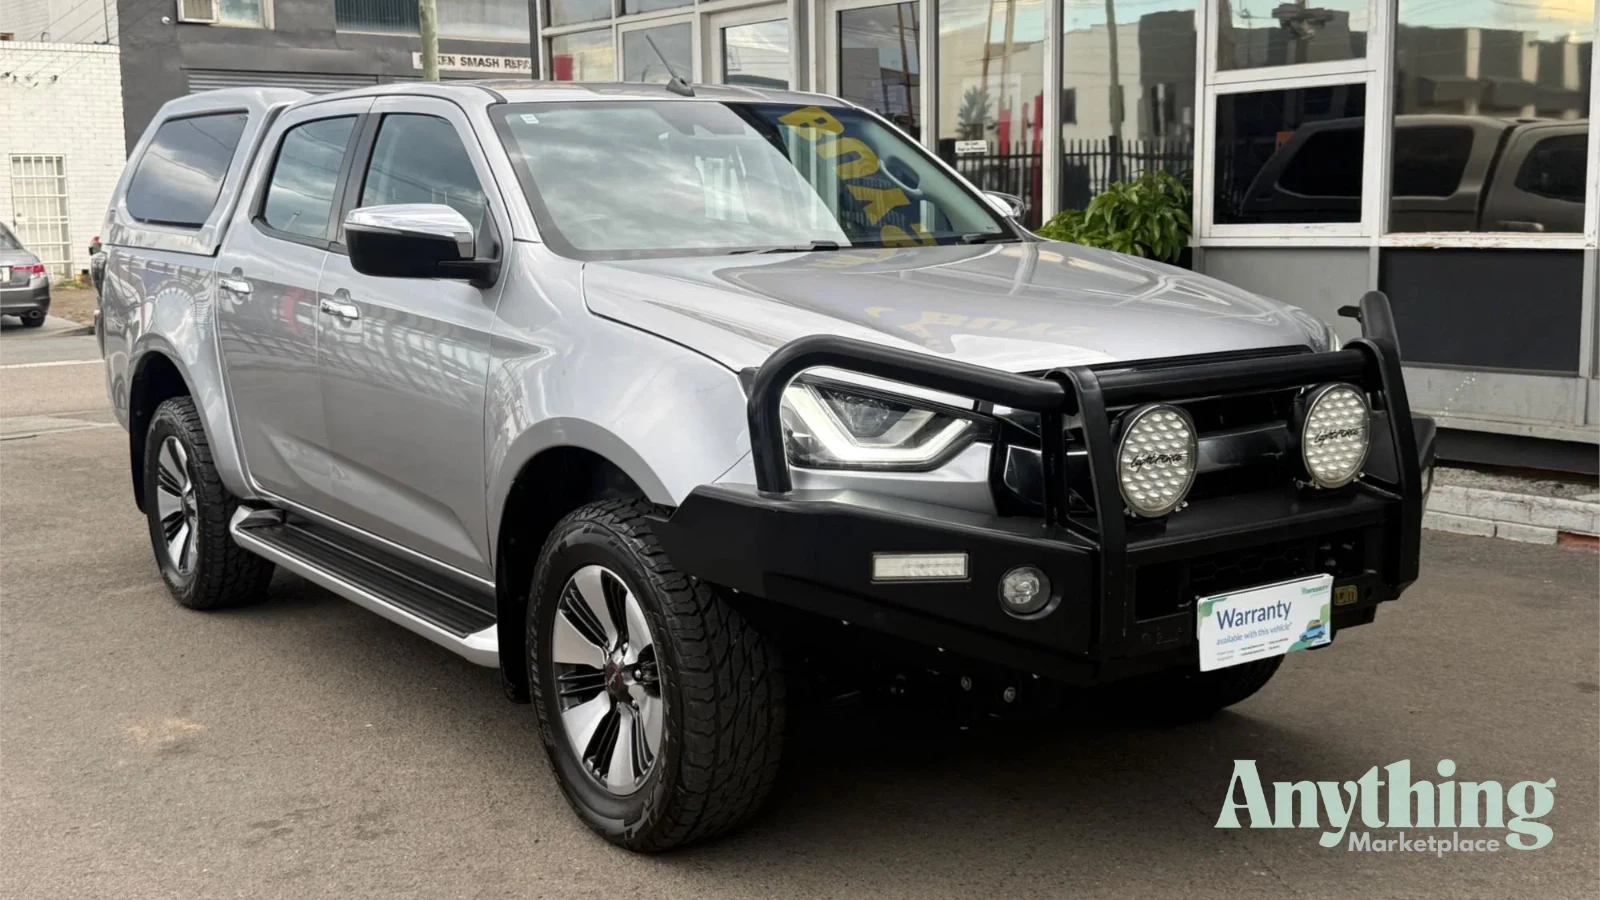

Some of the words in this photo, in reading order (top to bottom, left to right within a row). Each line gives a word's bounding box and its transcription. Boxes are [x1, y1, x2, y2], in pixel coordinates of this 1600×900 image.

[460, 56, 500, 68] SMASH
[1216, 600, 1292, 630] Warranty
[1216, 633, 1243, 645] available
[1244, 630, 1258, 639] with
[1258, 627, 1269, 637] this
